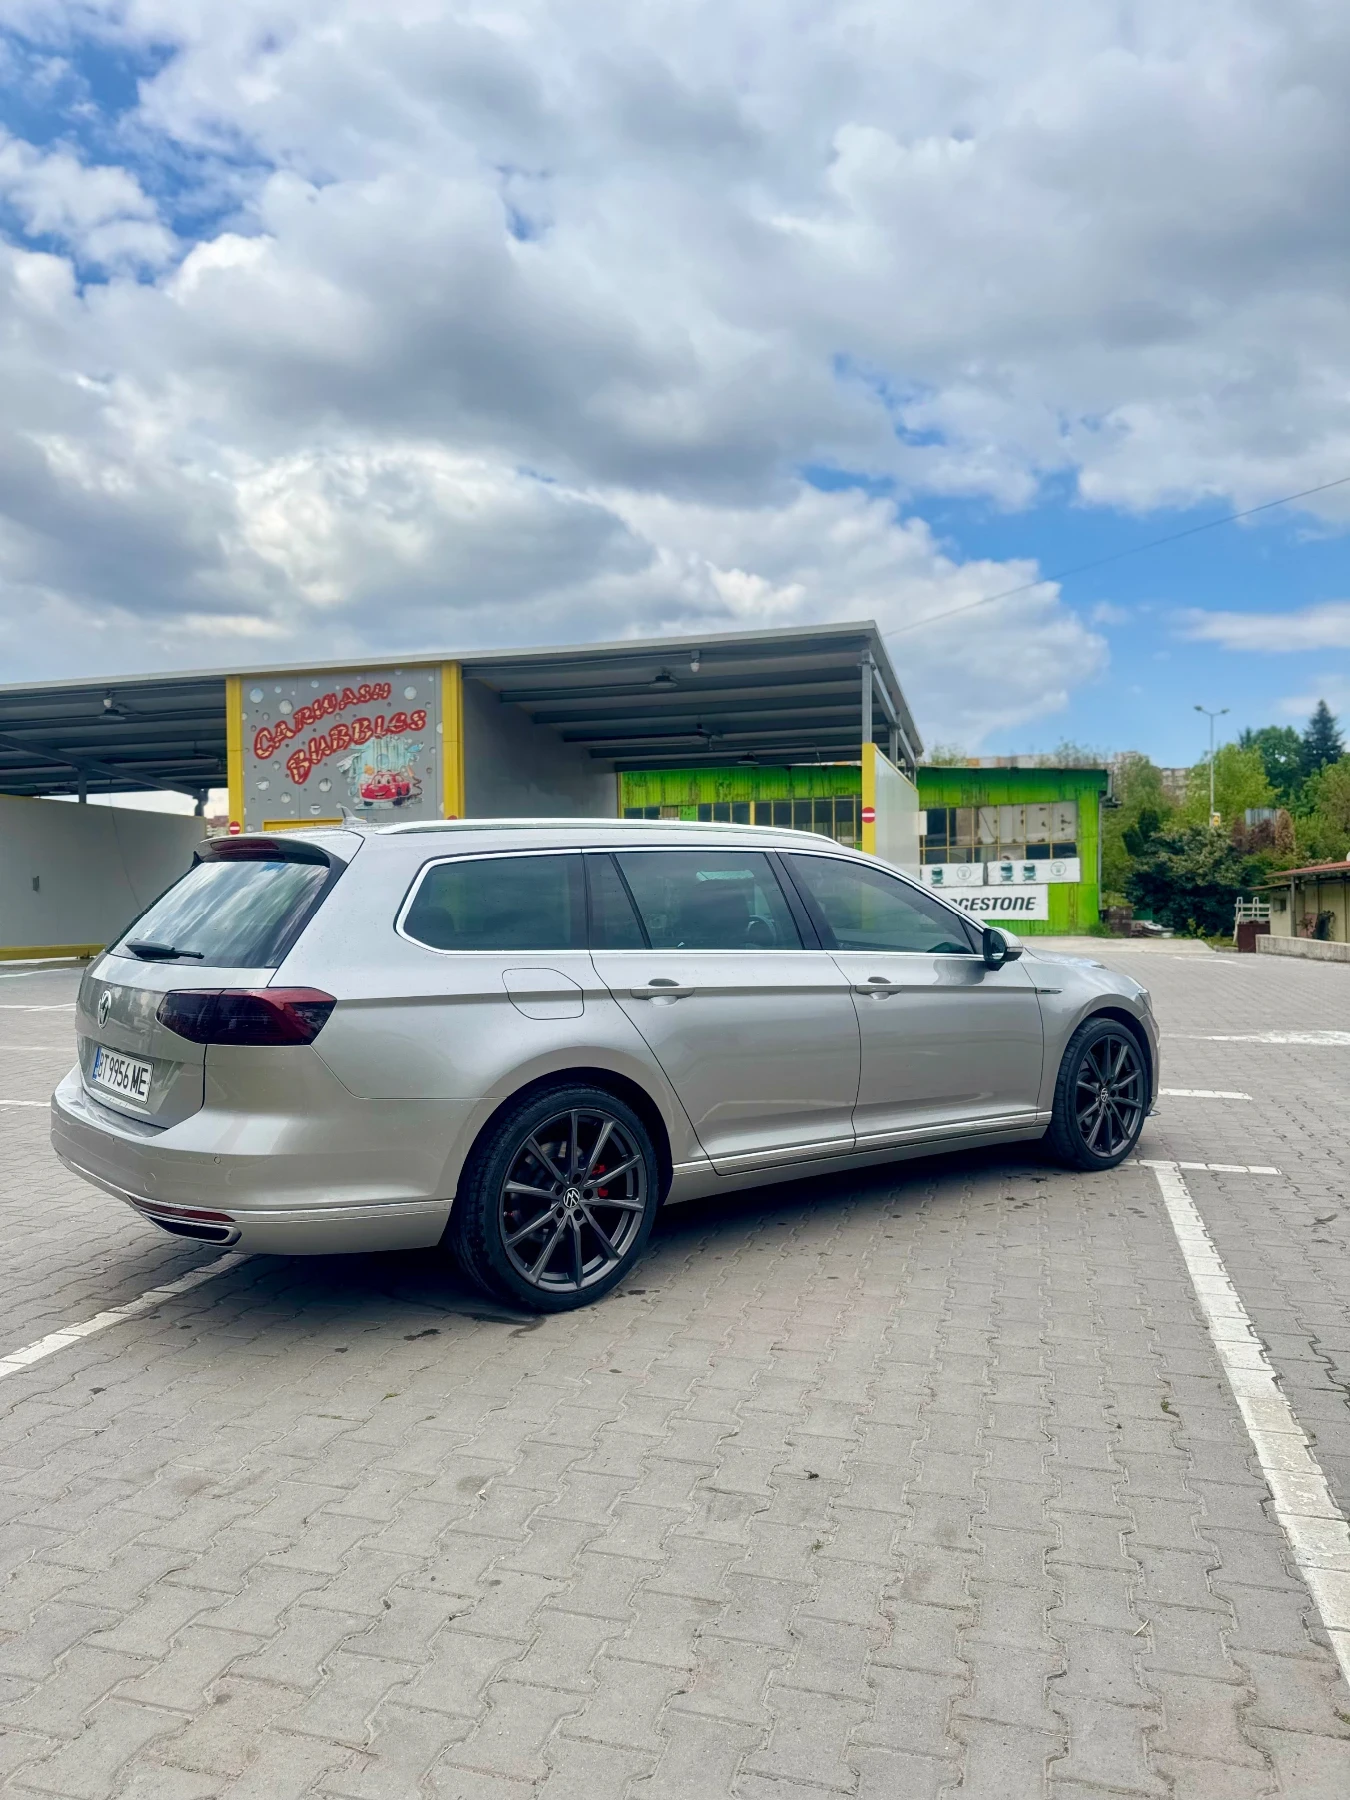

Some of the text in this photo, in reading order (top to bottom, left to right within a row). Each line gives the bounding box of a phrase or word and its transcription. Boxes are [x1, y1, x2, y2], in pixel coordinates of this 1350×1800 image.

[254, 682, 391, 759] CARWASH
[286, 710, 427, 785] BUBBLES
[107, 1057, 130, 1089] 9956
[130, 1064, 148, 1096] ME
